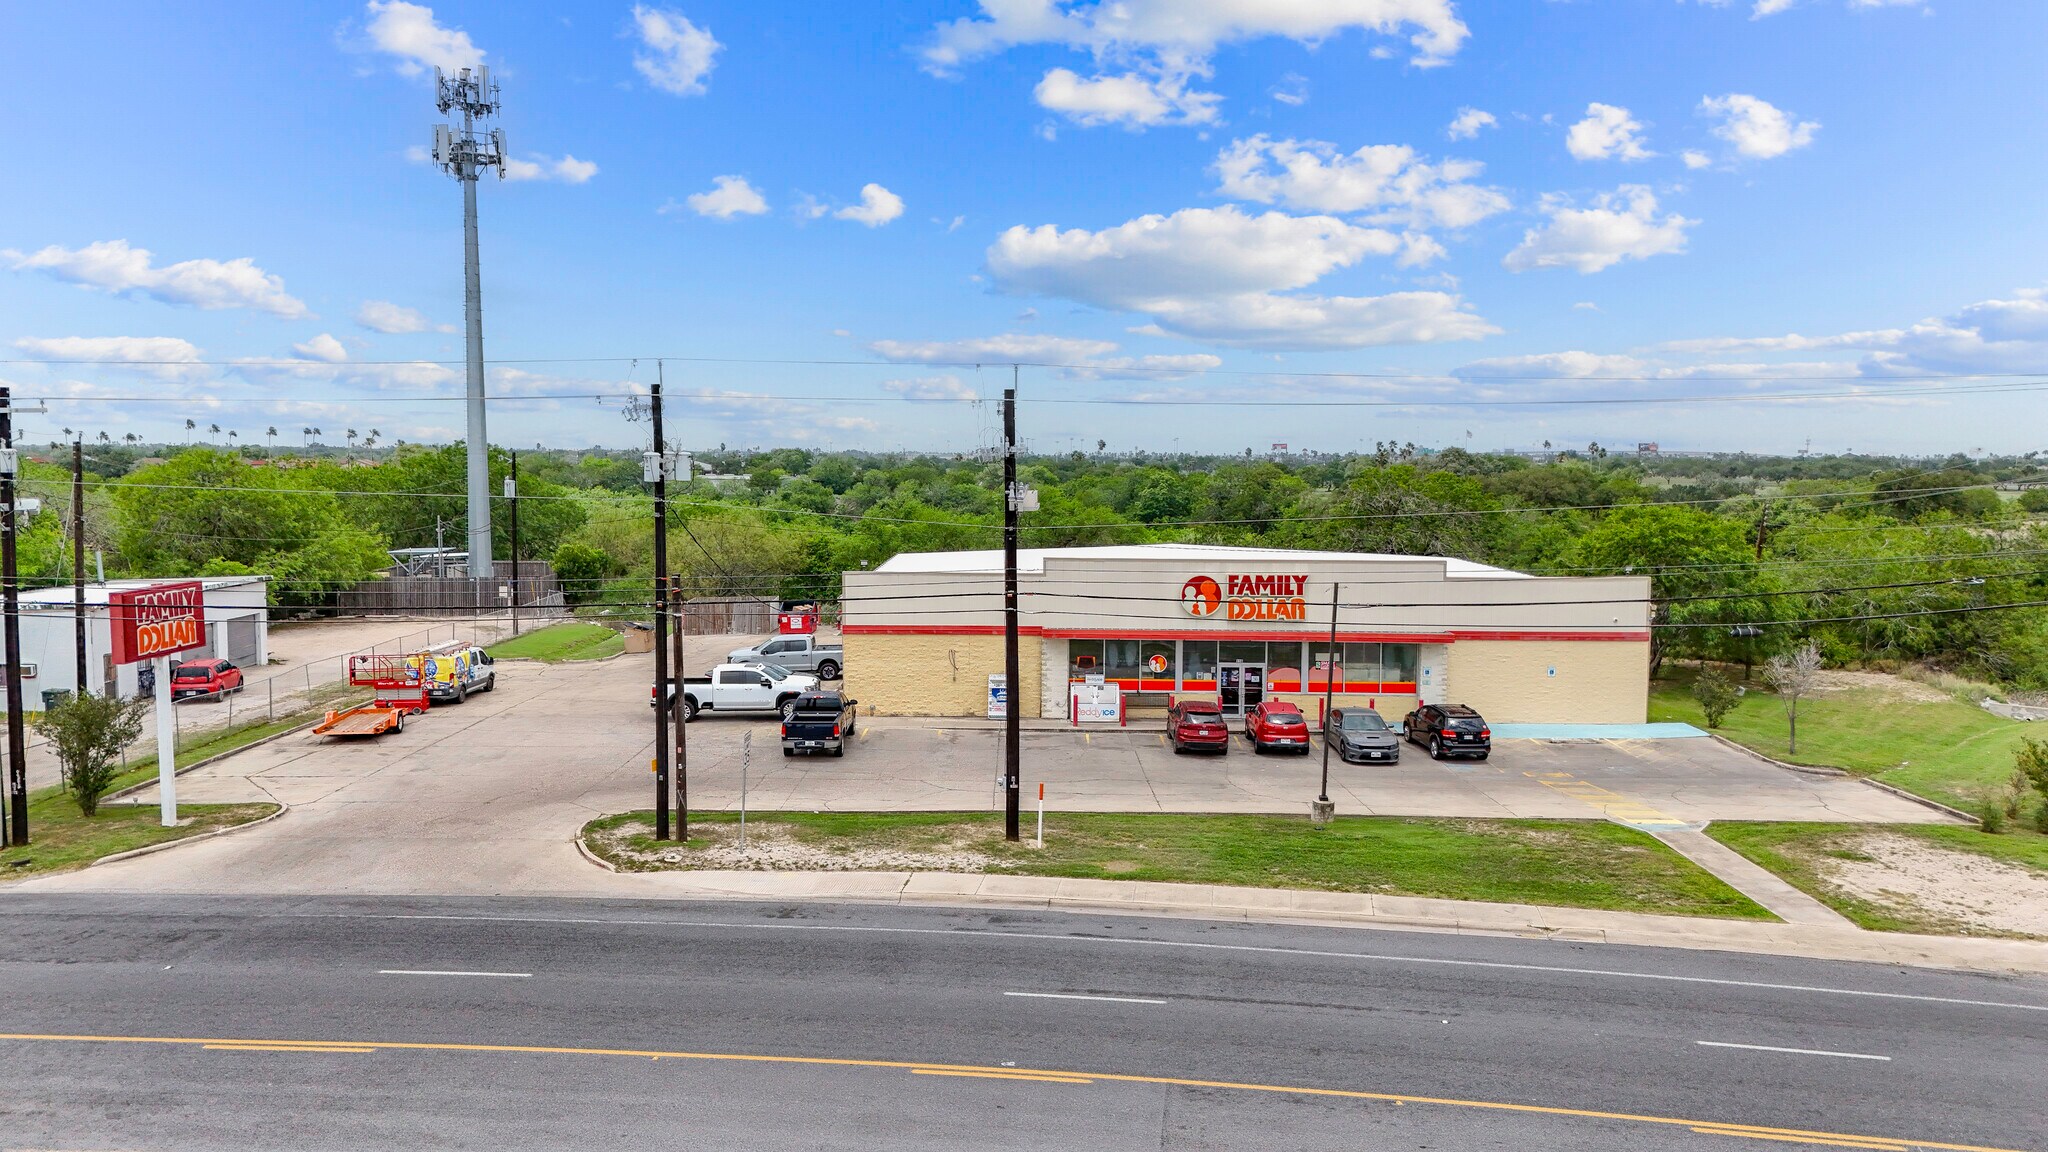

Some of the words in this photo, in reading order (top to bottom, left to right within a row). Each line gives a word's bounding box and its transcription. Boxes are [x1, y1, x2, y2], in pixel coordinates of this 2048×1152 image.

[1227, 574, 1309, 596] FAMILY
[135, 587, 196, 625] FAMILY
[1227, 597, 1306, 620] DOLLAR
[137, 616, 197, 656] DOLLAR
